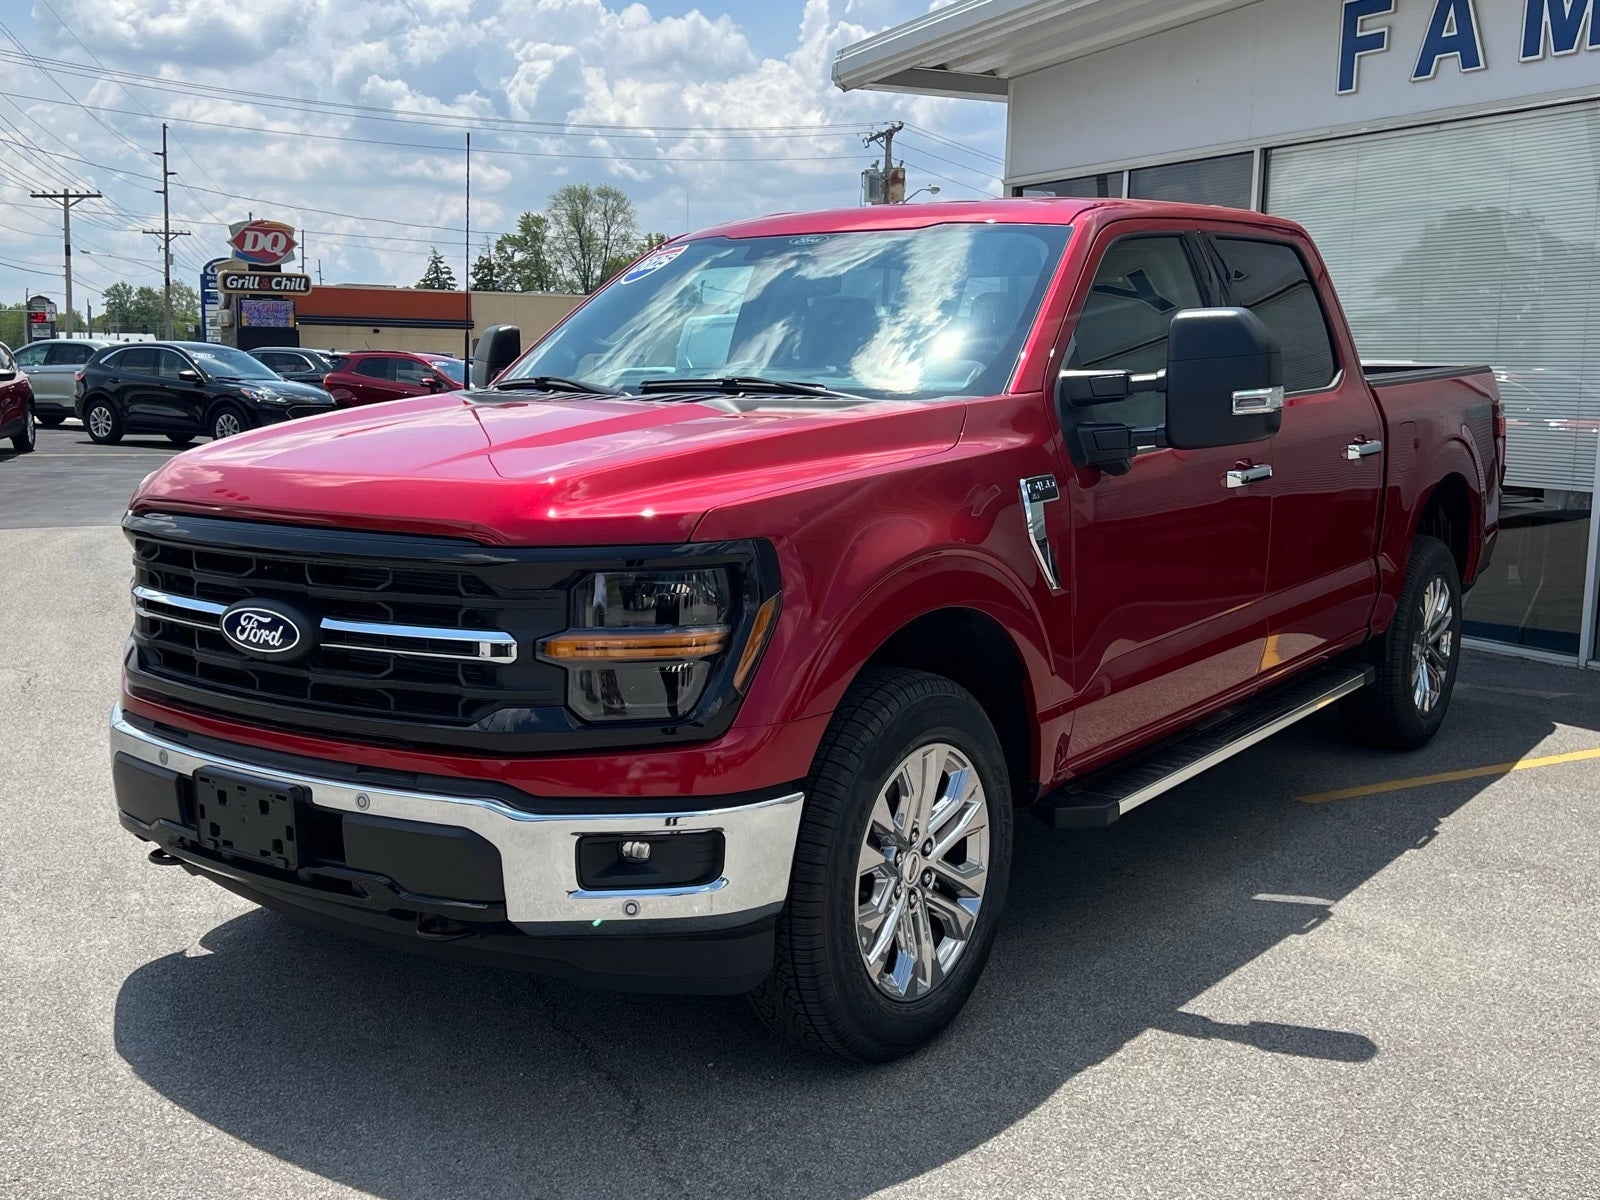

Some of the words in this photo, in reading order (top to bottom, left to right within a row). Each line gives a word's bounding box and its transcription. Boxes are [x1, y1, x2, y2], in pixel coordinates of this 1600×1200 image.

[242, 230, 287, 257] DQ
[226, 275, 260, 289] Grill
[271, 277, 306, 291] Chill
[236, 612, 284, 647] Ford
